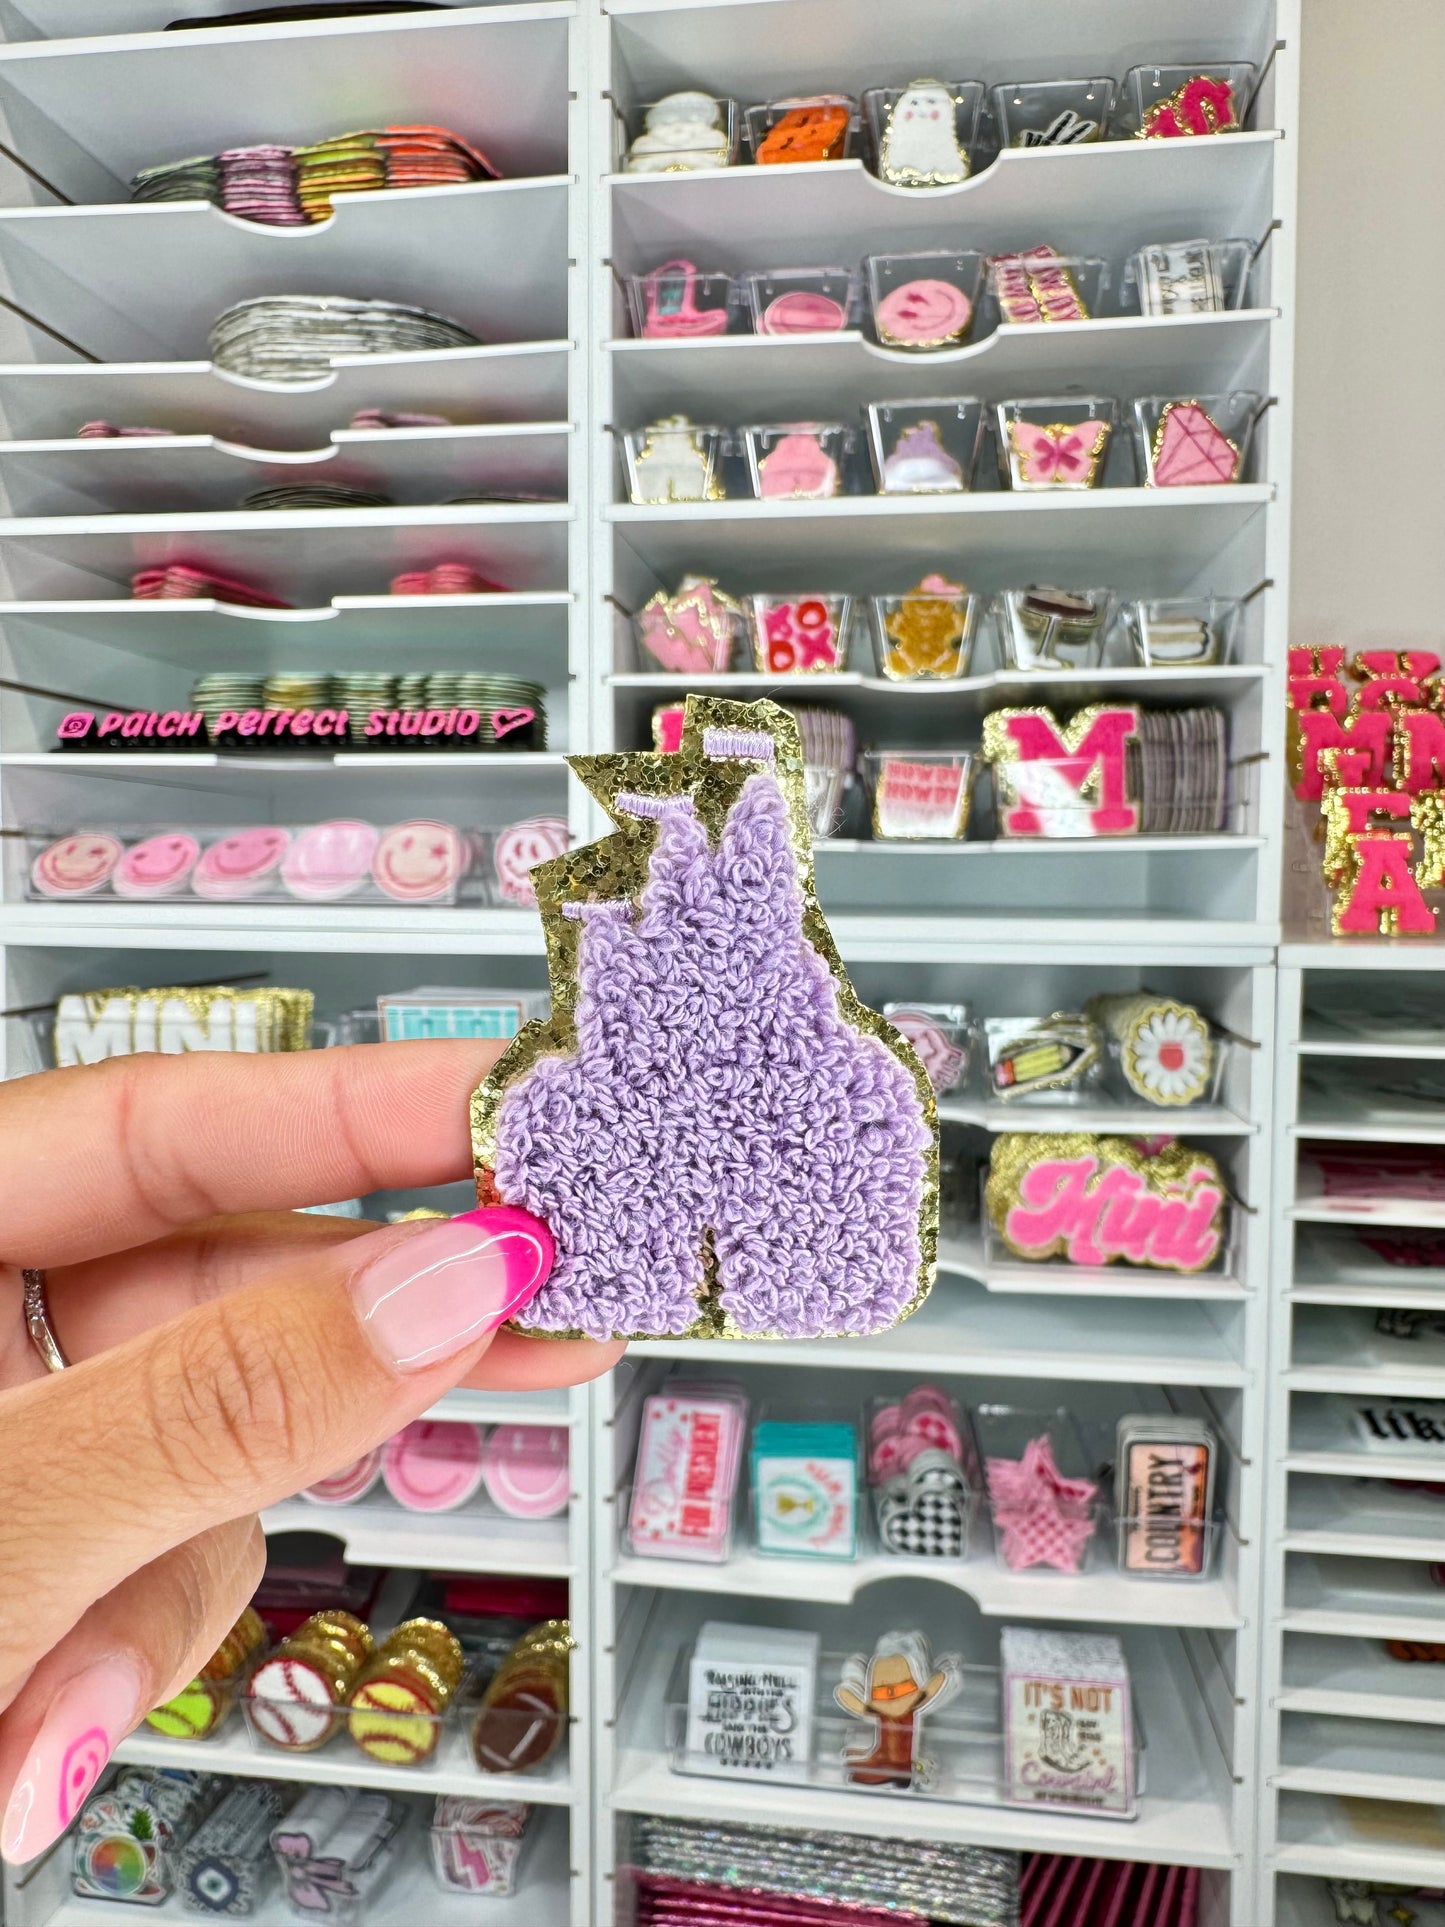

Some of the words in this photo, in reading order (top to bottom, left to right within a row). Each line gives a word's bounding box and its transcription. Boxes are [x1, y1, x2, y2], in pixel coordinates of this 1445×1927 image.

[1339, 838, 1437, 934] A
[1007, 1155, 1222, 1268] Mini
[1360, 1408, 1445, 1441] lik
[1144, 1453, 1183, 1563] COUNTRY
[1024, 1681, 1064, 1710] IT'S
[1070, 1686, 1112, 1714] NOT
[704, 1732, 793, 1762] COWBOYS
